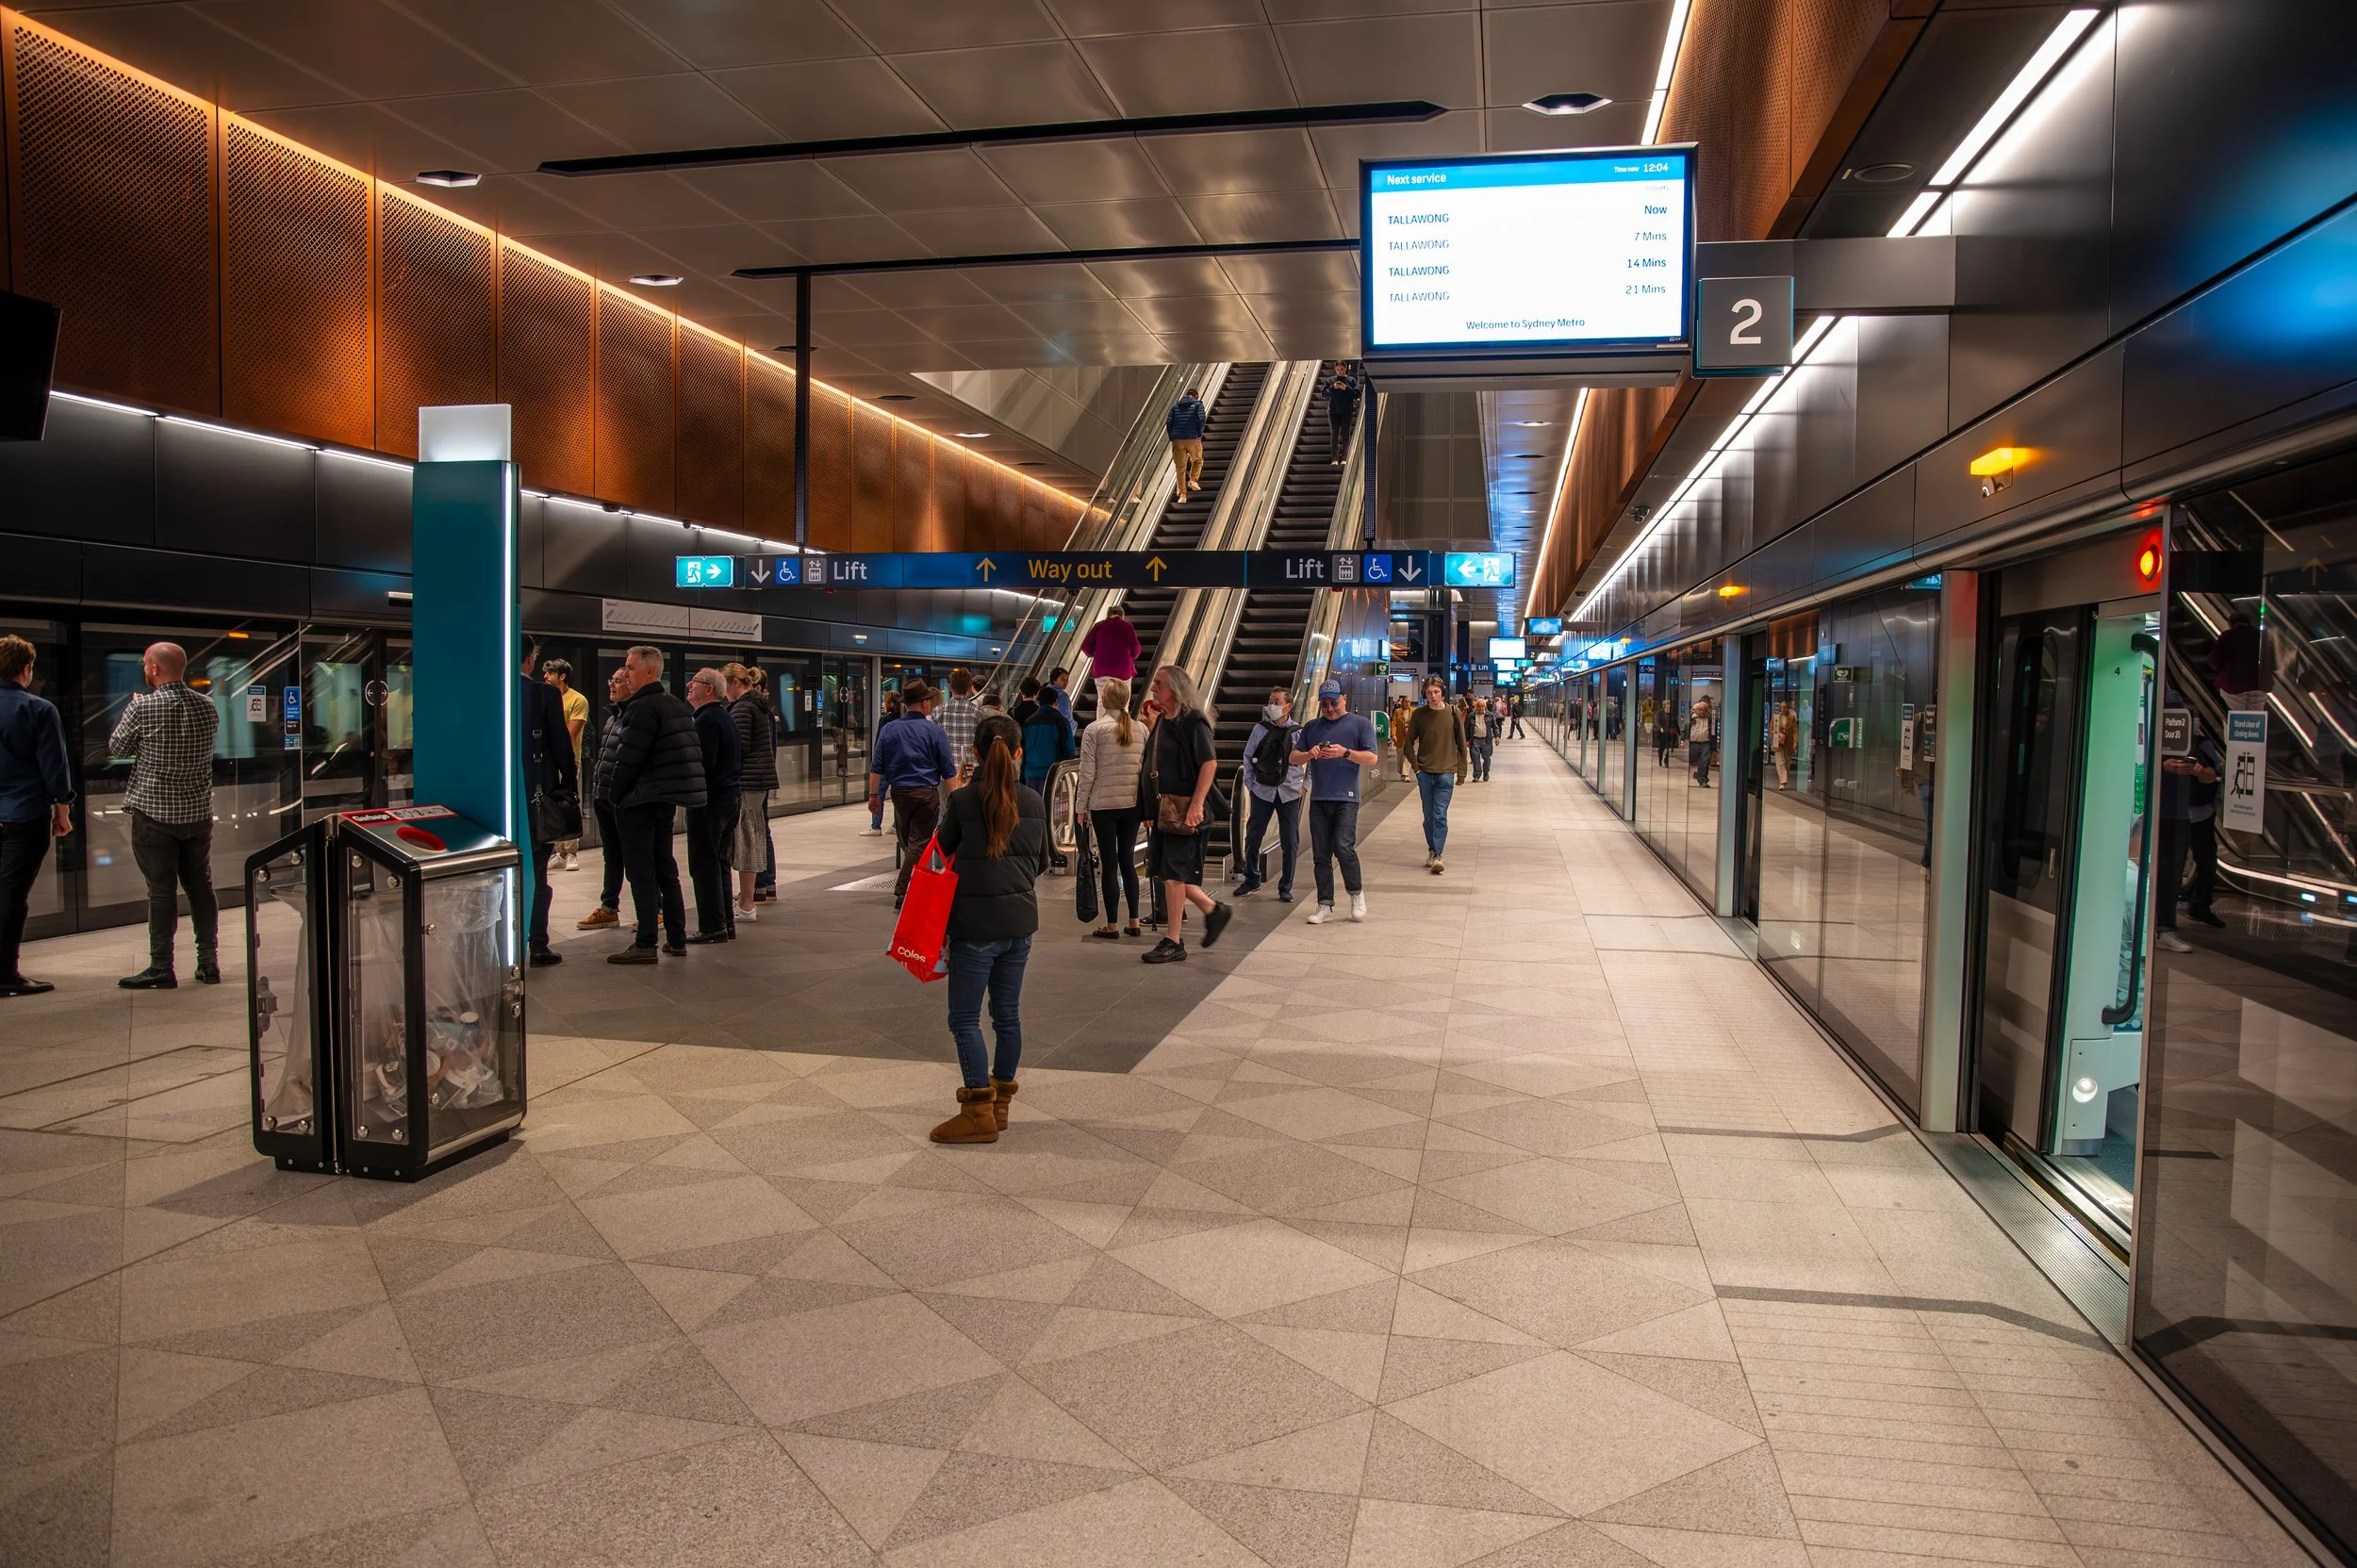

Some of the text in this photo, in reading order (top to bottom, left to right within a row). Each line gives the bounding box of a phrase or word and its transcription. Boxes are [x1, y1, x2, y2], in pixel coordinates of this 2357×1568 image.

[1643, 163, 1669, 173] 12:04
[1387, 173, 1447, 185] Next service
[1644, 205, 1668, 214] Now
[1388, 213, 1449, 224] TALLAWONG
[1635, 232, 1667, 240] 7 Mins
[1388, 239, 1449, 251] TALLAWONG
[1627, 258, 1666, 268] 14 Mins
[1388, 265, 1449, 276] TALLAWONG
[1625, 285, 1666, 294] 21 Mins
[1389, 291, 1449, 302] TALLAWONG
[1466, 321, 1508, 329] Welcome
[1522, 319, 1556, 329] Sydney
[1557, 318, 1585, 327] Metro
[1729, 298, 1762, 345] 2
[833, 561, 867, 580] Lift
[1029, 559, 1113, 583] Way out
[1285, 558, 1324, 579] Lift
[2115, 667, 2120, 675] 4
[2165, 718, 2185, 727] Platform 2
[2233, 719, 2246, 729] Stand
[2165, 730, 2175, 739] Door
[2233, 730, 2259, 739] closing doors
[898, 946, 926, 963] coles
